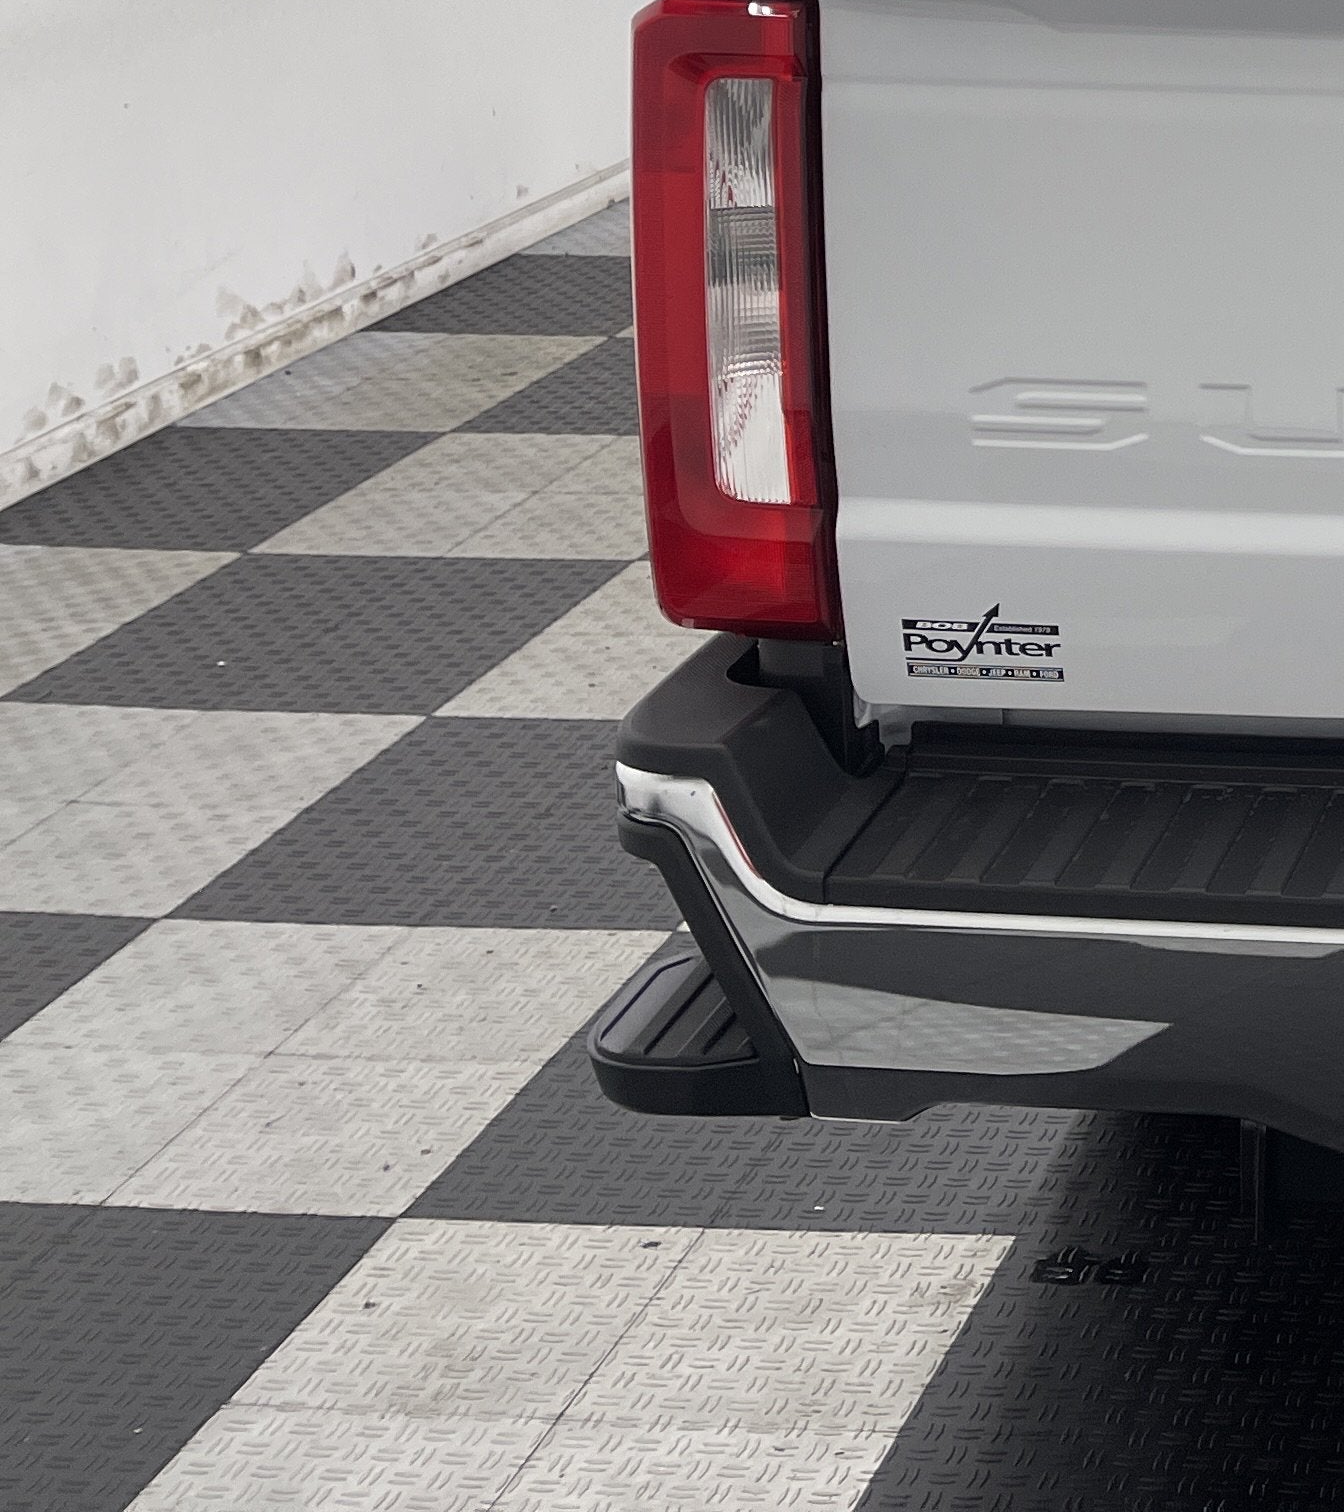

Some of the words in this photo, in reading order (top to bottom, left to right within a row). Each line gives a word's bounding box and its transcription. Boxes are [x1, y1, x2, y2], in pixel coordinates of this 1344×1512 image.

[915, 621, 969, 630] BOB
[903, 632, 1061, 661] Poynter
[912, 665, 949, 675] CHRYSLER
[988, 668, 1006, 677] JEEP
[1013, 669, 1031, 678] RAM
[1039, 670, 1059, 679] FORD
